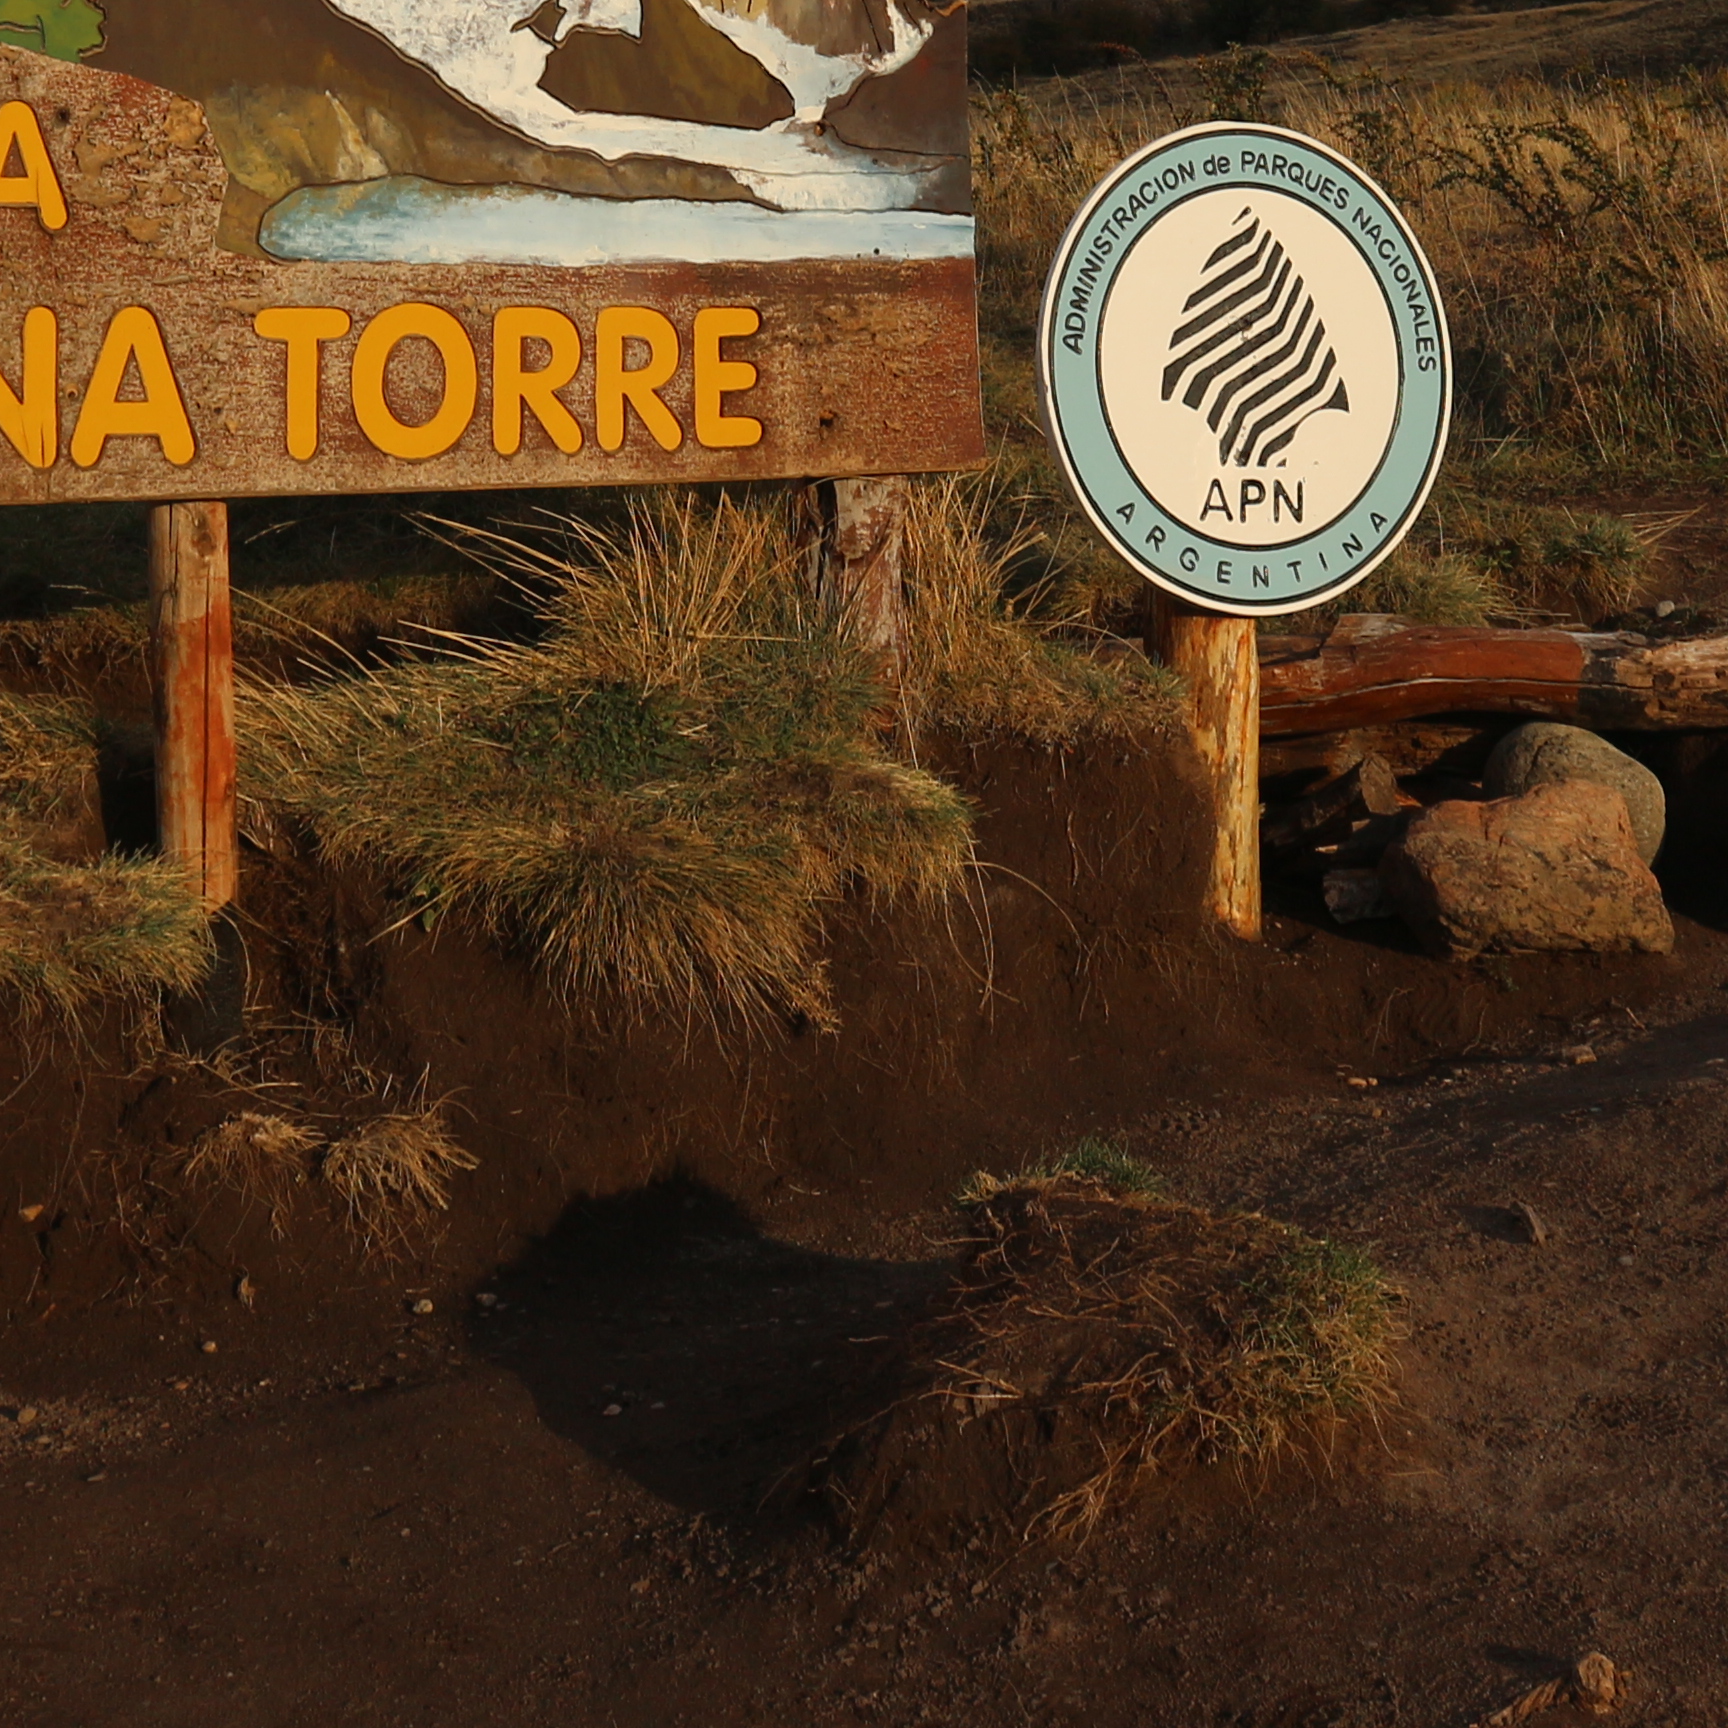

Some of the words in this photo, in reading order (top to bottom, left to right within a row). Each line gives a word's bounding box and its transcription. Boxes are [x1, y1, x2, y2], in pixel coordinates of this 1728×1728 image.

[1062, 160, 1197, 355] ADMINISTRACION
[1202, 153, 1231, 176] de
[1240, 150, 1351, 210] PARQUES
[1352, 208, 1437, 372] NACIONALES
[253, 302, 763, 461] TORRE
[1116, 501, 1388, 588] ARGENTINA
[1200, 478, 1306, 524] APN
